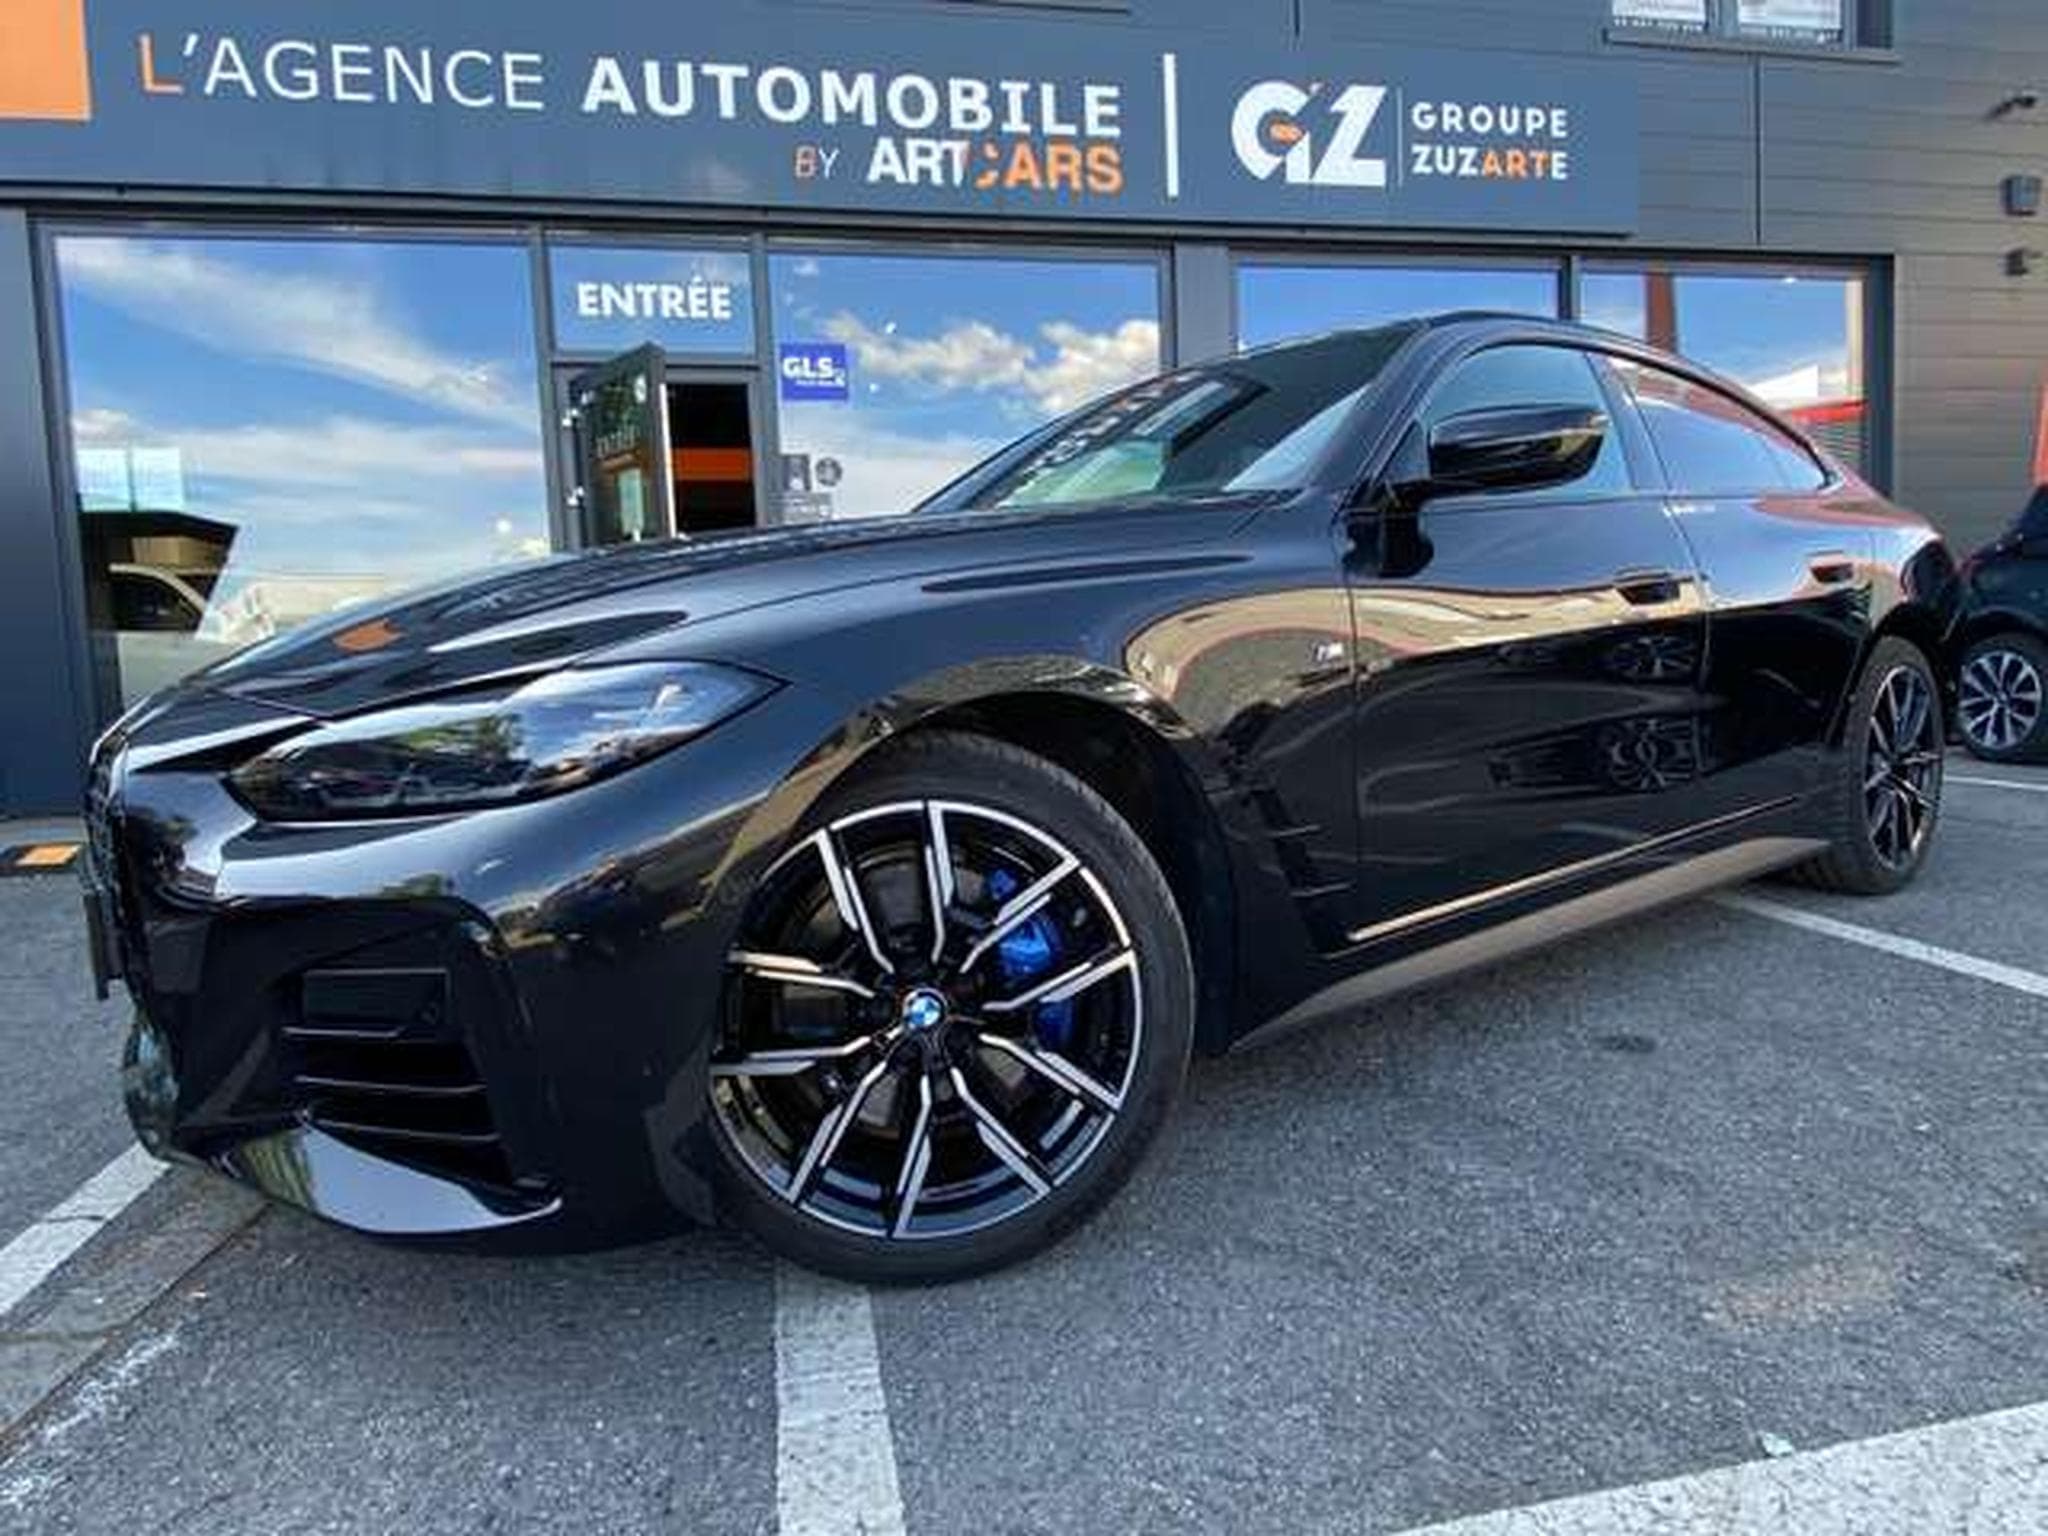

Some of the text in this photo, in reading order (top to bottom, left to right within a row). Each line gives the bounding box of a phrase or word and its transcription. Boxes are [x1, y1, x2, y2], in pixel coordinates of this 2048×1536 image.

[138, 34, 1122, 137] L'AGENCE AUTOMOBILE
[1411, 102, 1568, 138] GROUPE
[795, 146, 840, 178] BY
[1411, 144, 1568, 181] ZUZARTE
[576, 275, 733, 319] ENTRÉE
[783, 356, 833, 379] GLS
